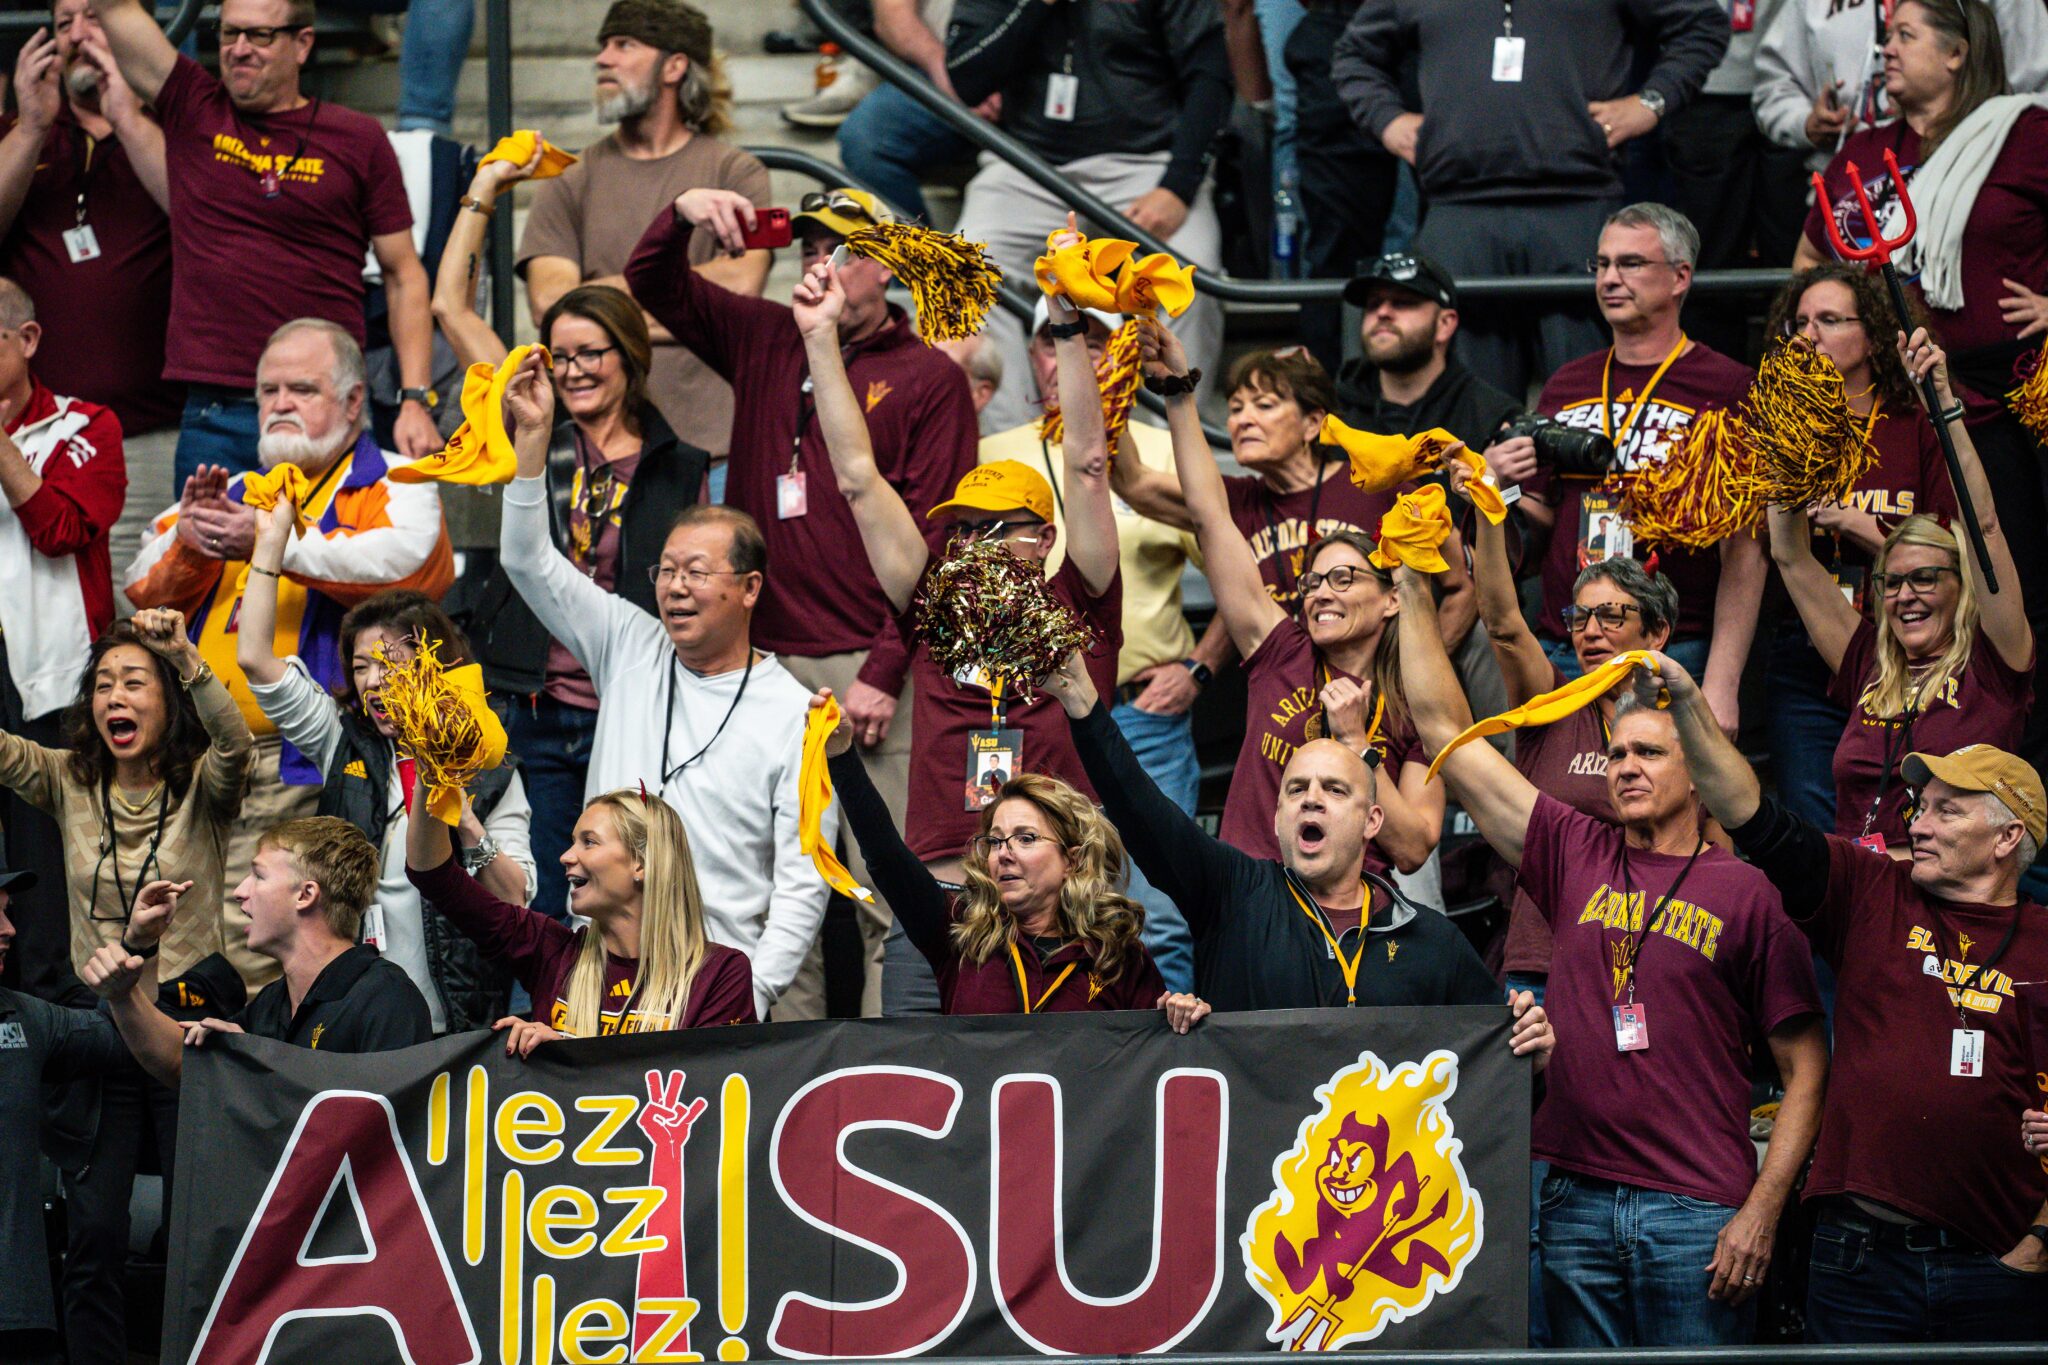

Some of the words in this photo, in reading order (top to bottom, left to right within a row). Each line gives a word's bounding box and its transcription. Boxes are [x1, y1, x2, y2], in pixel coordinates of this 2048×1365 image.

[1270, 687, 1322, 728] ARIZ
[980, 737, 998, 748] ASU
[1567, 751, 1609, 777] ARIZ
[1649, 895, 1725, 962] STATE
[1906, 925, 1937, 953] SU
